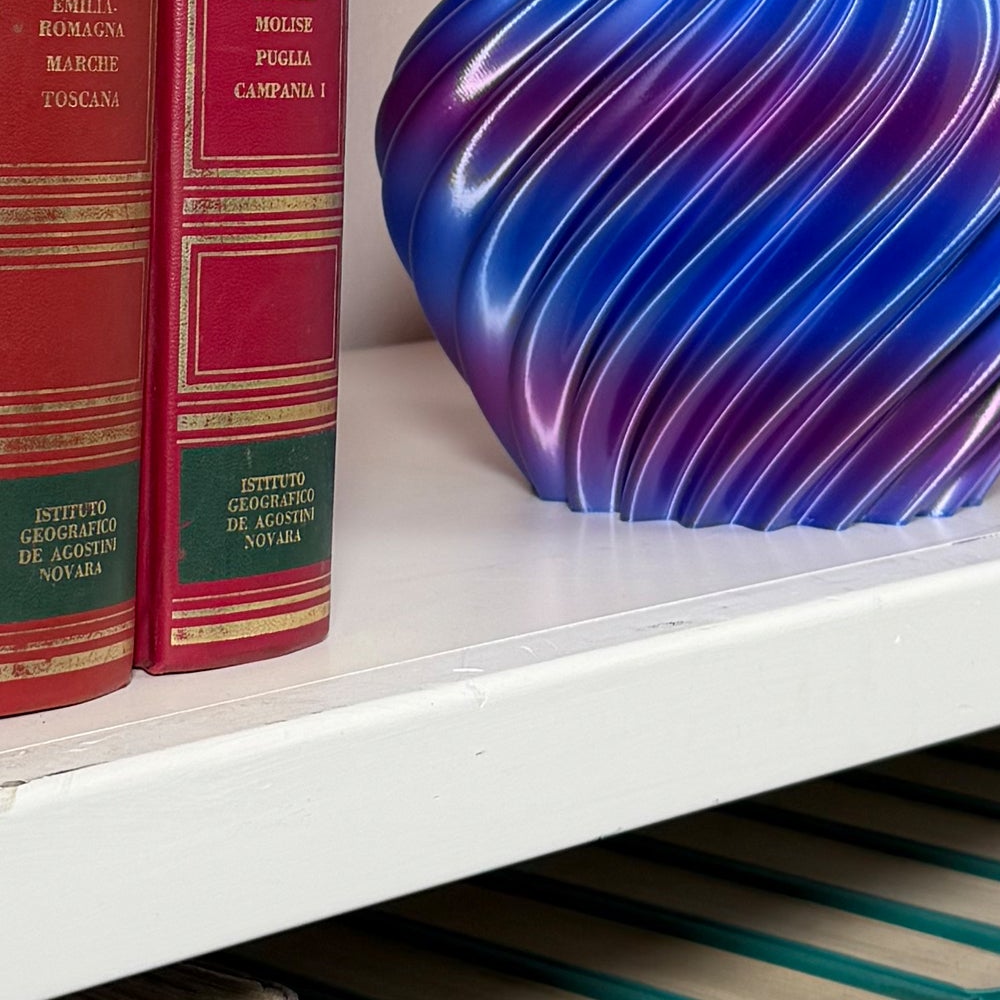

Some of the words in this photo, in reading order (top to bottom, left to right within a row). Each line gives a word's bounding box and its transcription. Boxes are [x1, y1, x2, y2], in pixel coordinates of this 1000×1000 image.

[39, 21, 125, 38] ROMAGNA
[256, 16, 313, 33] MOLISE
[47, 56, 119, 72] MARCHE
[255, 50, 312, 67] PUGLIA
[42, 91, 120, 109] TOSCANA
[234, 82, 314, 99] CAMPANIA
[321, 83, 326, 99] I
[241, 471, 306, 493] ISTITUTO
[227, 488, 315, 513] GEOGRAFICO
[35, 500, 107, 524] ISTITUTO
[226, 516, 248, 533] DE
[255, 507, 315, 531] AGOSTINI
[20, 517, 117, 545] GEOGRAFICO
[244, 529, 302, 550] NOVARA
[19, 547, 43, 566] DE
[51, 537, 117, 562] AGOSTINI
[39, 561, 102, 582] NOVARA
